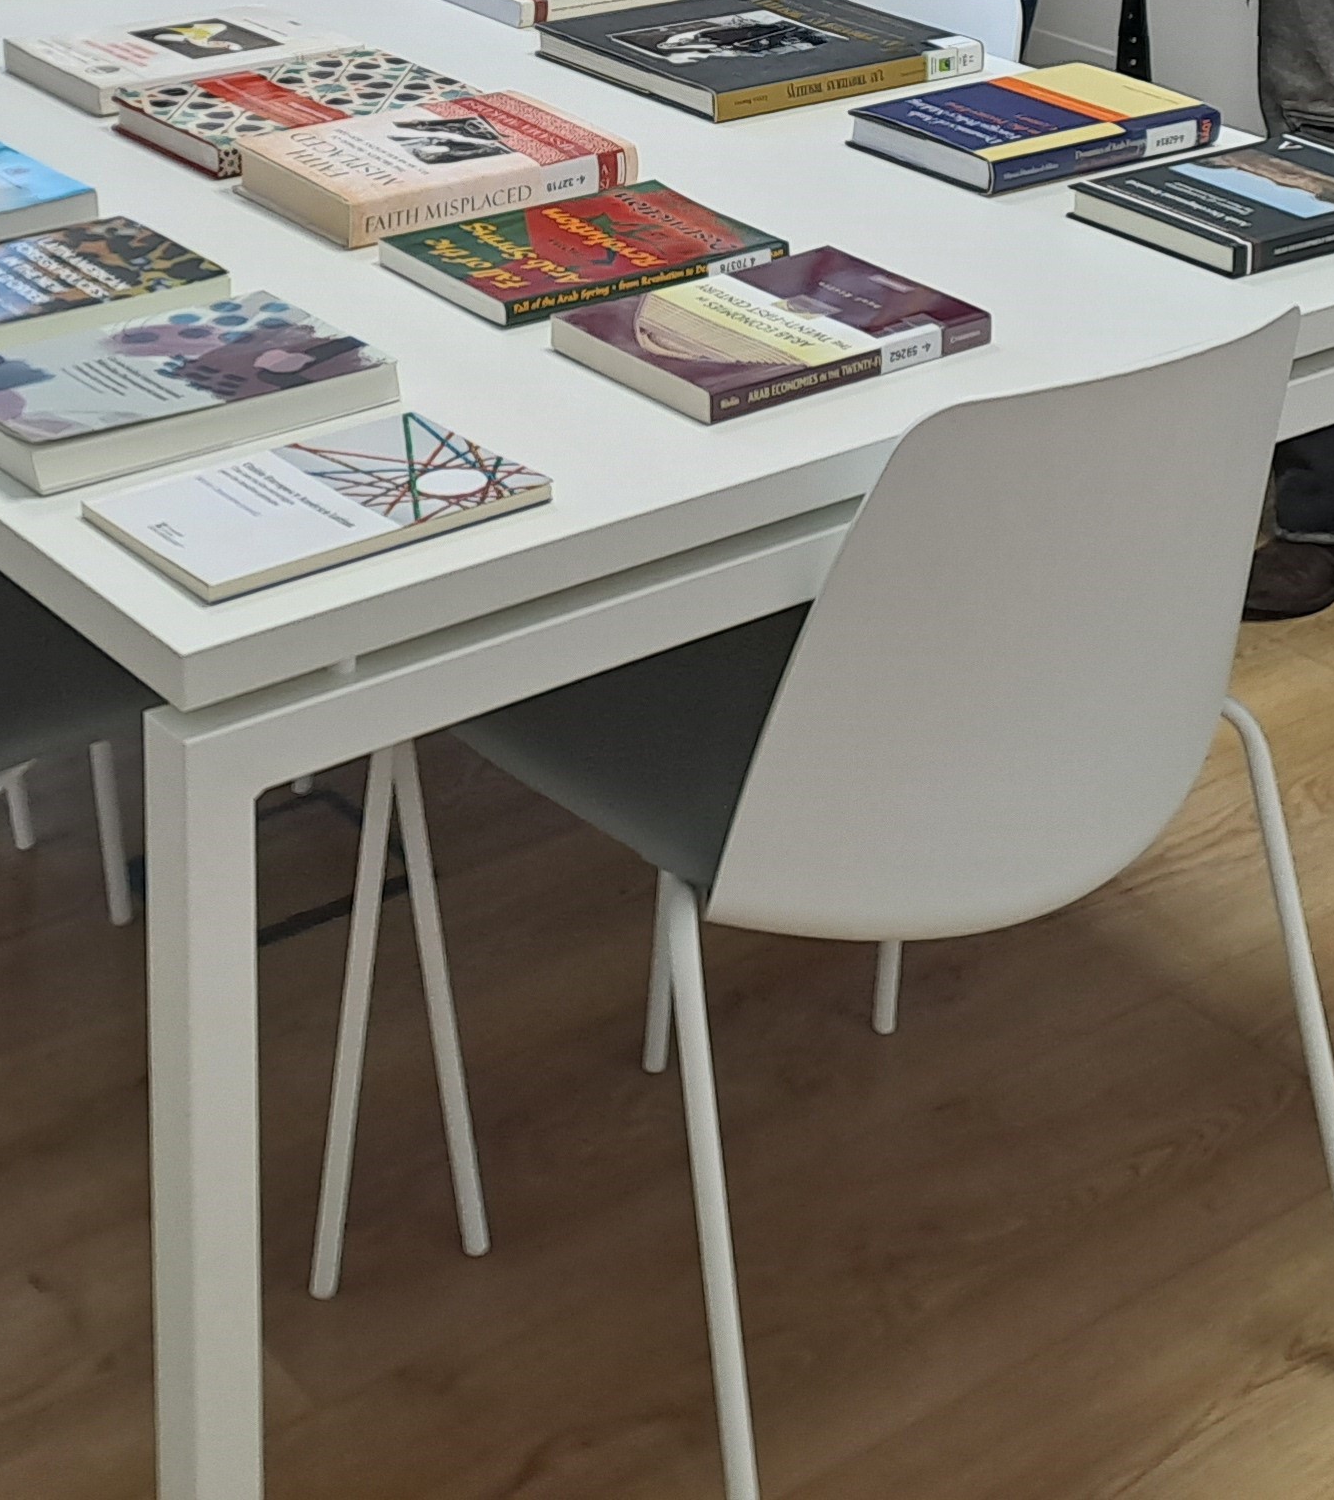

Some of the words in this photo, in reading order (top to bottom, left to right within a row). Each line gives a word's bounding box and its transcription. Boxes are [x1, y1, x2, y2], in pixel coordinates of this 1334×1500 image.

[365, 207, 420, 234] FAITH
[425, 184, 533, 222] MISPLACED
[425, 238, 462, 263] the
[460, 221, 537, 263] Spring
[485, 265, 529, 289] Fall
[530, 259, 591, 285] Arab
[513, 302, 530, 315] Fall
[530, 298, 540, 310] of
[541, 295, 556, 308] the
[557, 290, 580, 305] Arab
[581, 284, 611, 302] Spring
[691, 283, 756, 315] CENTURY
[703, 299, 778, 338] ECONOMIES
[754, 306, 835, 346] TWENTY-FIRST
[776, 327, 816, 348] ARAB
[748, 387, 771, 403] ARAB
[771, 373, 819, 397] ECONOMIES
[828, 369, 840, 380] THE
[841, 354, 882, 376] TWENTY-FI
